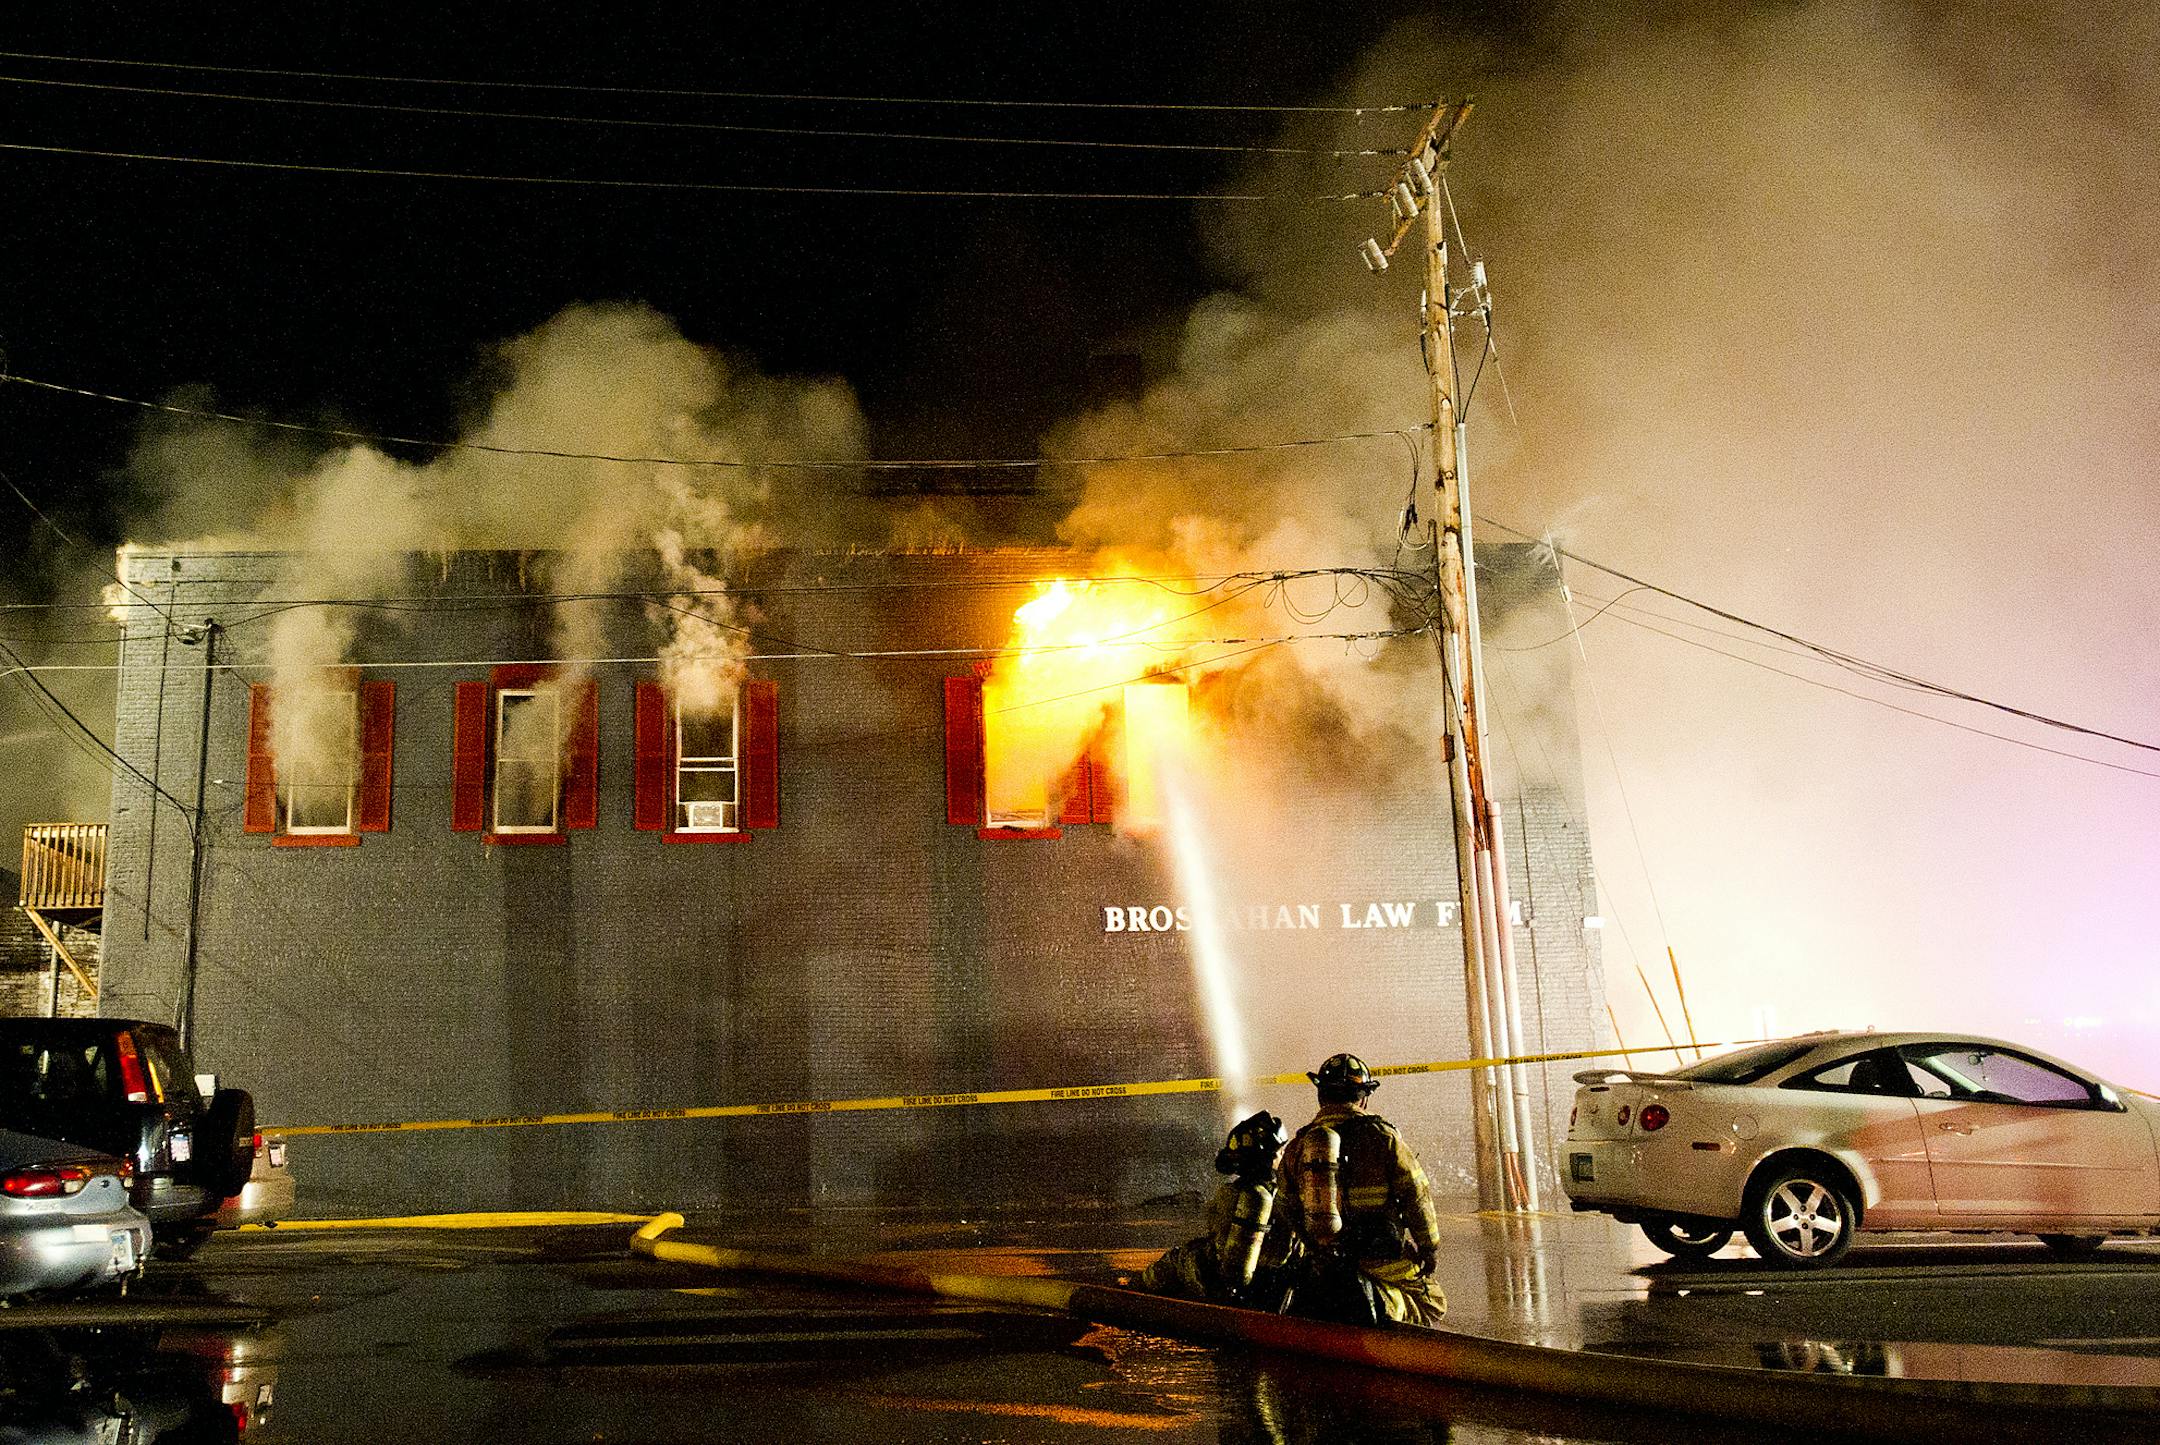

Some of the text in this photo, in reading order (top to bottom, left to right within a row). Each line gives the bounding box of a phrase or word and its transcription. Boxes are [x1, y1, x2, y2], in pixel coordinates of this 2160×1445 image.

[1104, 904, 1321, 932] BROSAHAN
[1339, 902, 1416, 929] LAW
[1393, 1067, 1406, 1075] NOT
[1407, 1065, 1429, 1074] CROSS
[1200, 1081, 1214, 1089] FIRE
[1051, 1090, 1064, 1098] FIRE
[1066, 1089, 1079, 1097] LINE
[1091, 1088, 1104, 1096] NOT
[1106, 1086, 1126, 1095] CROSS
[918, 1097, 932, 1105] LINE
[934, 1096, 942, 1104] DO
[957, 1095, 978, 1103] CROSS
